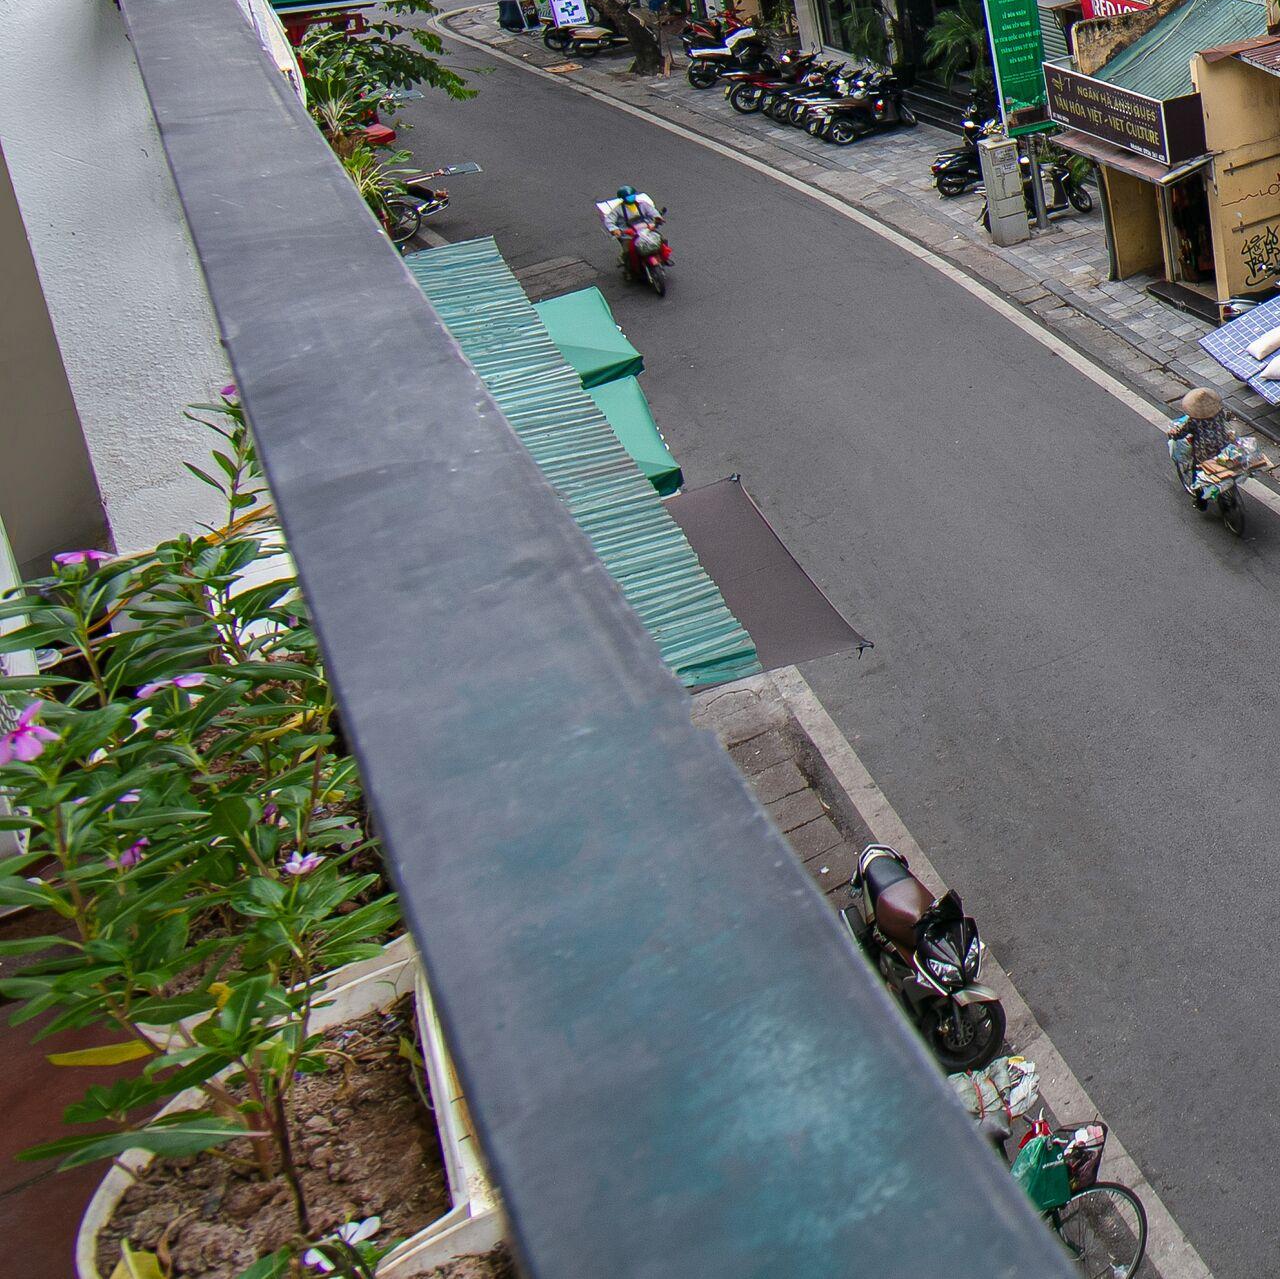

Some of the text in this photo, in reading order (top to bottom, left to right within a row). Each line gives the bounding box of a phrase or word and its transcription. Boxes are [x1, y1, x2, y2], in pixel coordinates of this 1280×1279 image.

[1116, 2, 1140, 15] LO
[1077, 86, 1099, 101] NGÂN
[1100, 91, 1112, 105] HÀ
[1054, 93, 1069, 112] VĂN
[1069, 99, 1086, 118] HÓA
[1087, 105, 1103, 126] VIỆT
[1108, 114, 1126, 133] VIET
[1126, 120, 1161, 146] CULTURE
